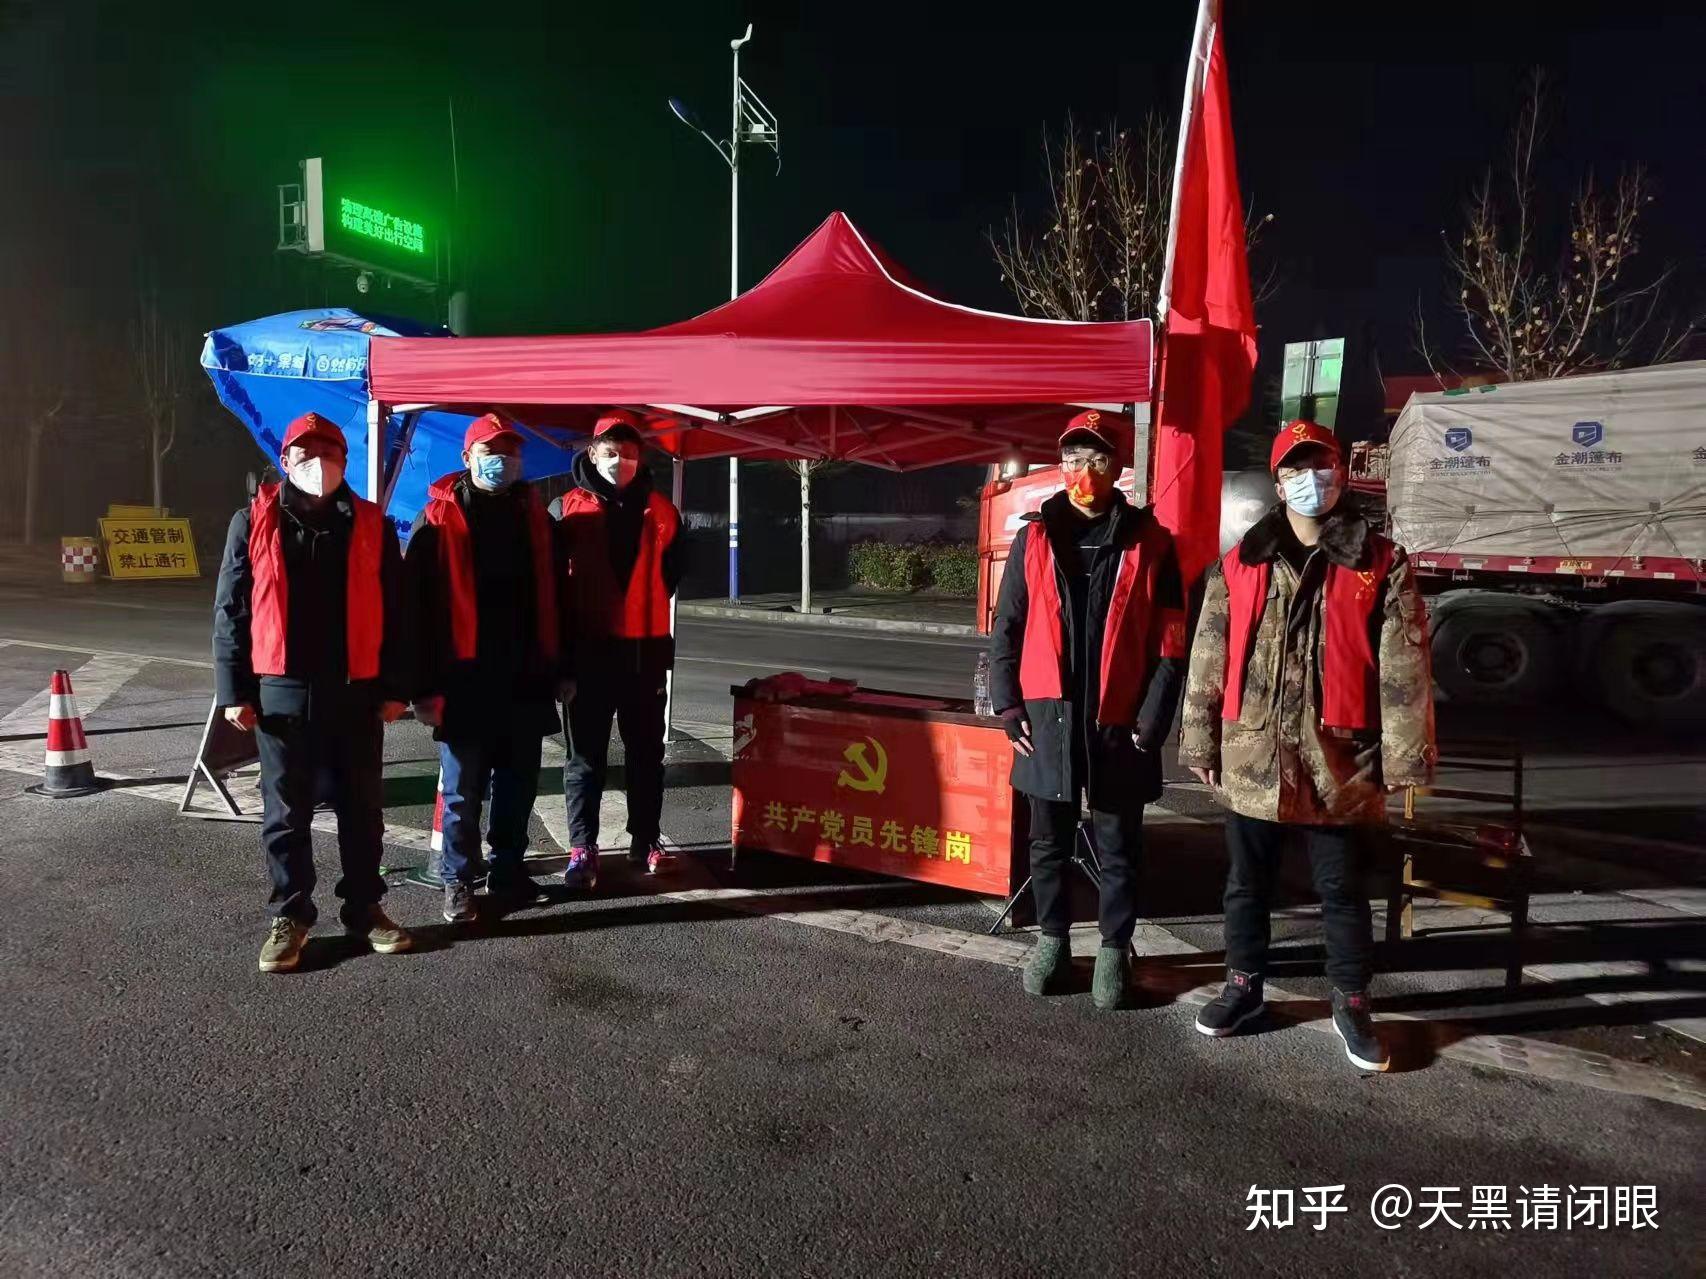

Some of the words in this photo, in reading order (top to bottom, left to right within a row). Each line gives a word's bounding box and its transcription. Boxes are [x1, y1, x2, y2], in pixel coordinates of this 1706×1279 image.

[1429, 455, 1492, 470] 金潮篷布
[1555, 450, 1623, 465] 金潮篷布
[112, 527, 184, 545] 交通管制
[118, 552, 188, 569] 禁止通行
[763, 801, 973, 865] 共产党员先锋岗
